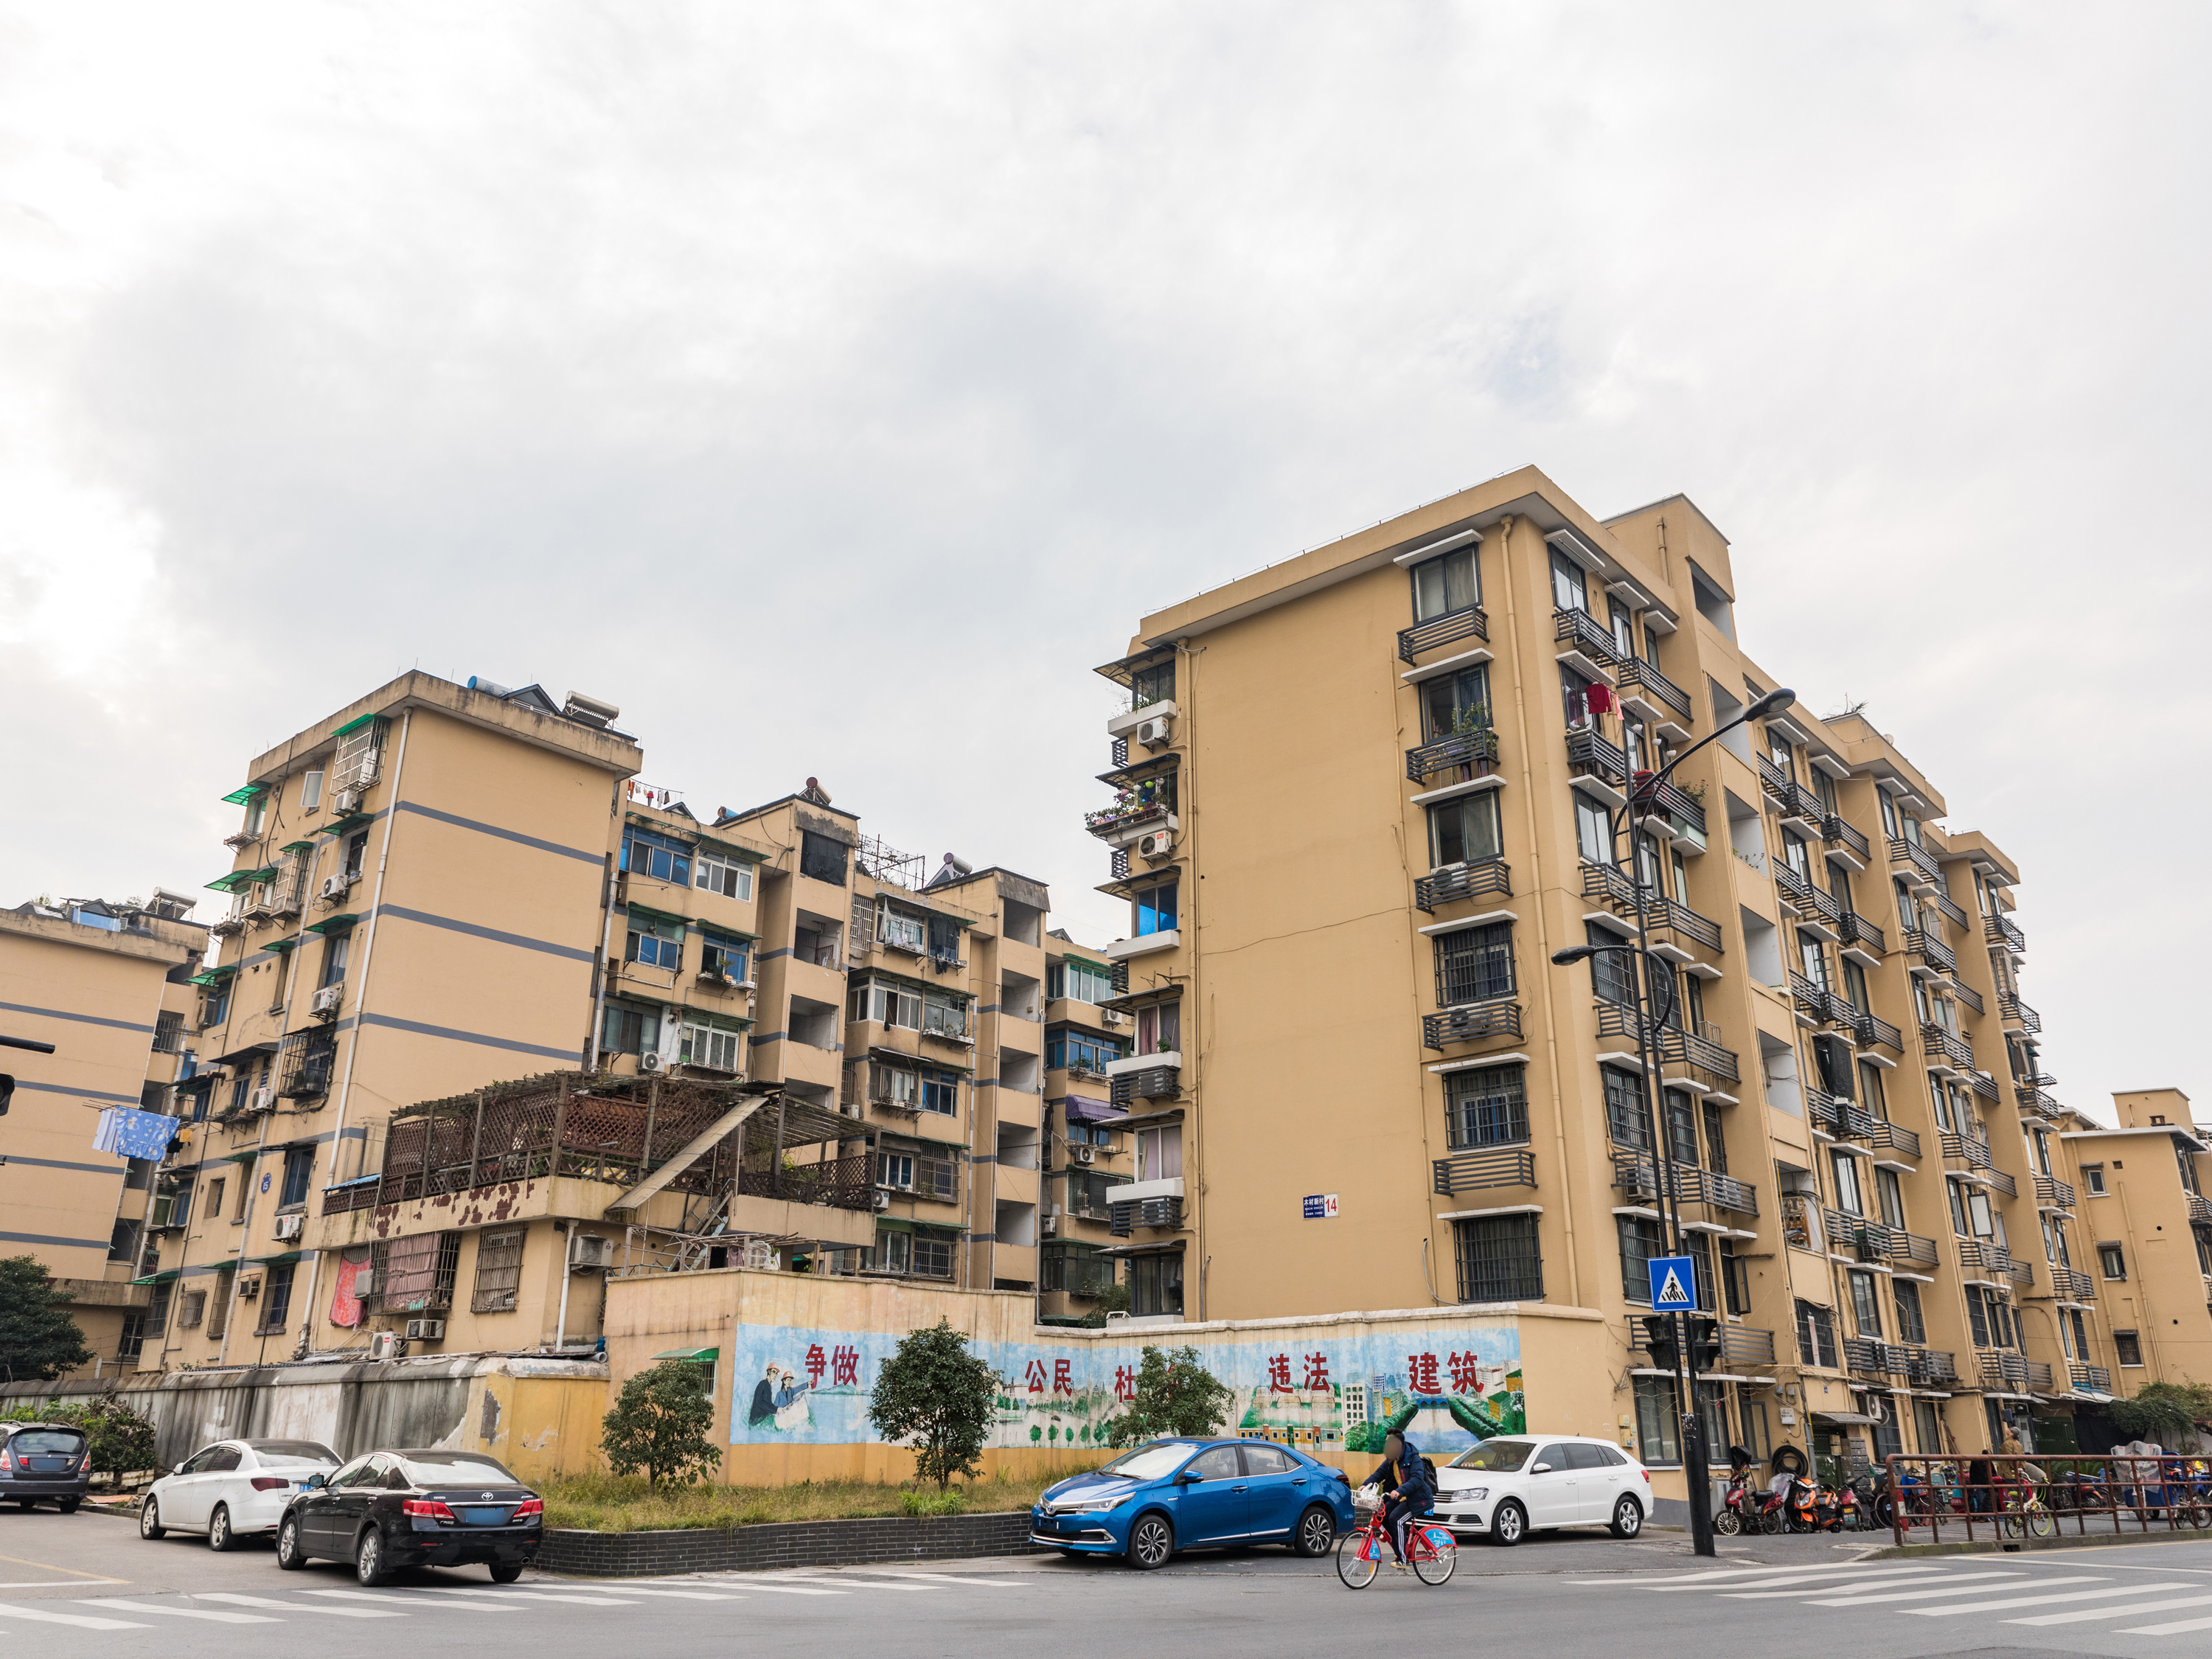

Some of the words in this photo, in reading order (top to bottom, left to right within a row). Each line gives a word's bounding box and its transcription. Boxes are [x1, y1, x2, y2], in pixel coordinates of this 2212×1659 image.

[1304, 1197, 1324, 1206] 木材新村
[1326, 1197, 1337, 1213] 14
[804, 1343, 859, 1389] 争做
[1024, 1359, 1073, 1397] 公民
[1267, 1352, 1331, 1394] 违法
[1408, 1350, 1484, 1395] 建筑
